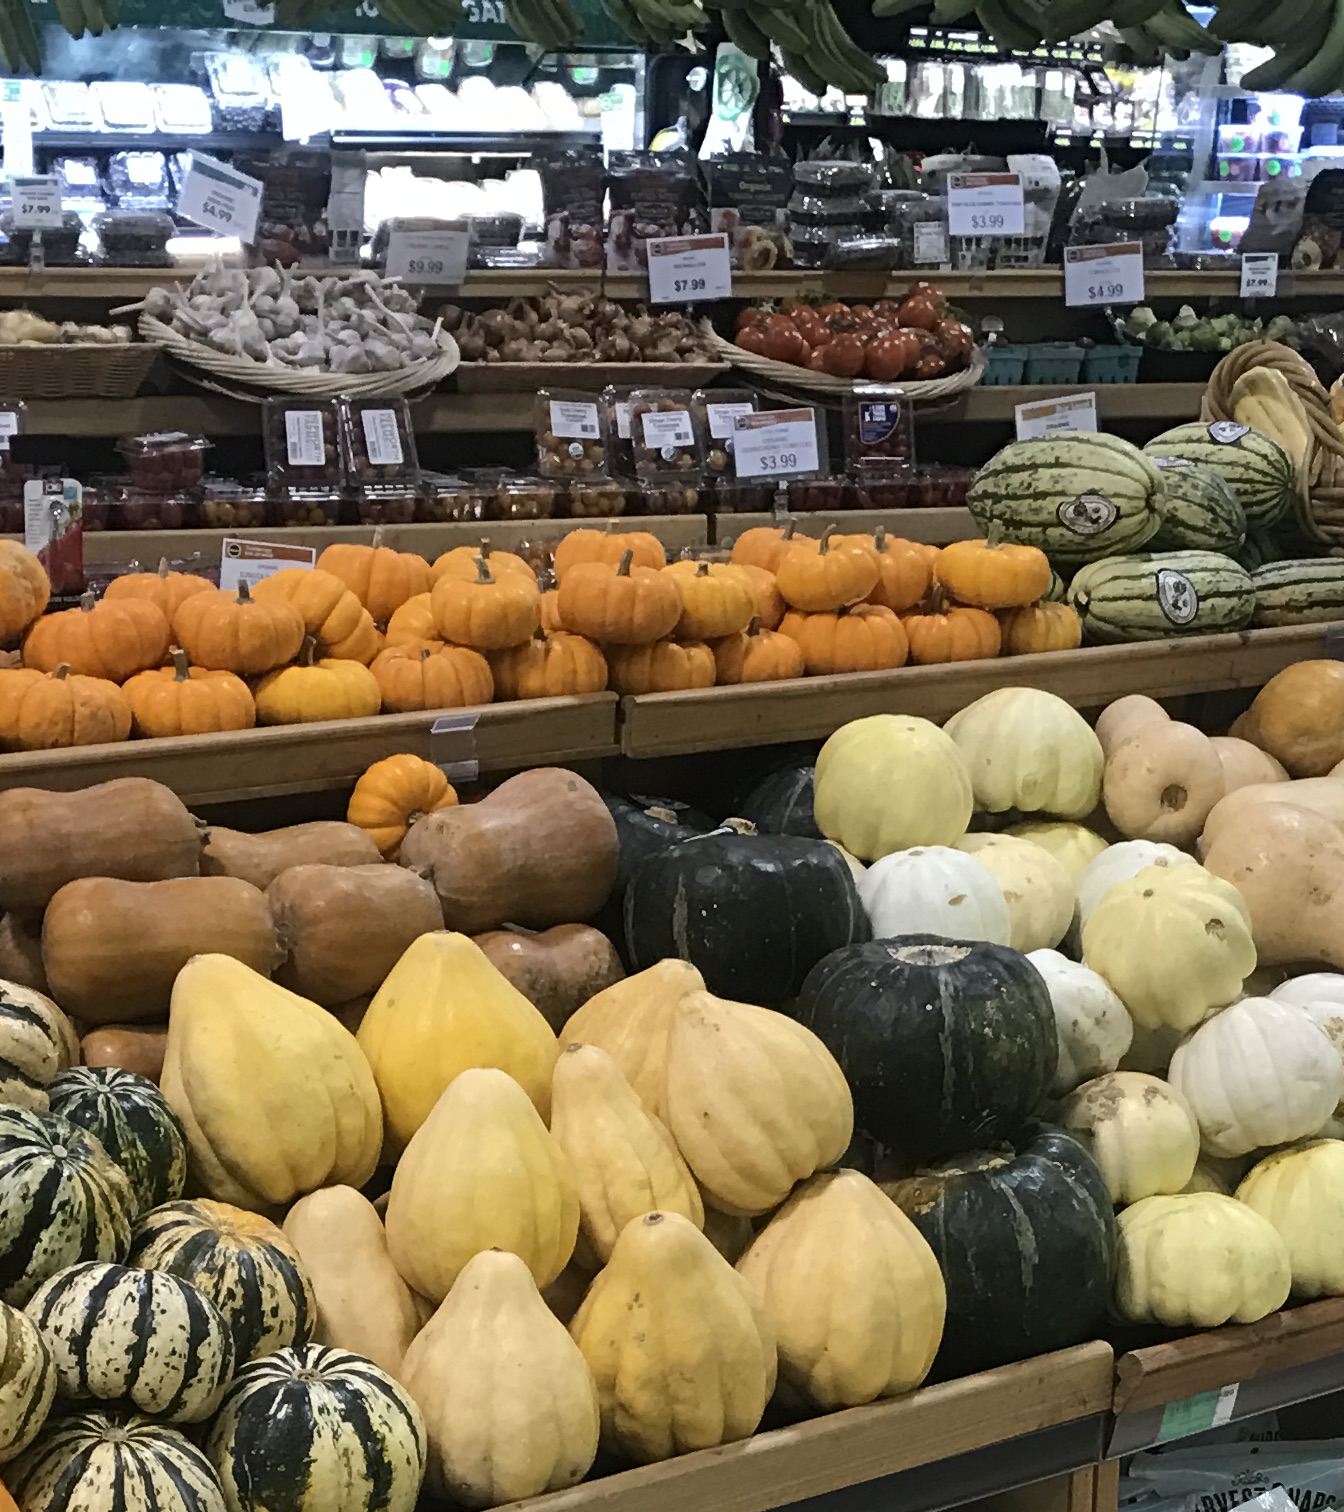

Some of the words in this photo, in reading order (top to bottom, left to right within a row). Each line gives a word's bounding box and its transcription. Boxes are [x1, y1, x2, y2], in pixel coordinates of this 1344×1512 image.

[21, 203, 51, 214] $7.99
[971, 214, 1004, 229] $3.99
[408, 260, 443, 274] $9.99
[674, 278, 706, 293] $7.99
[1088, 284, 1123, 299] $4.99
[760, 453, 797, 470] $3.99
